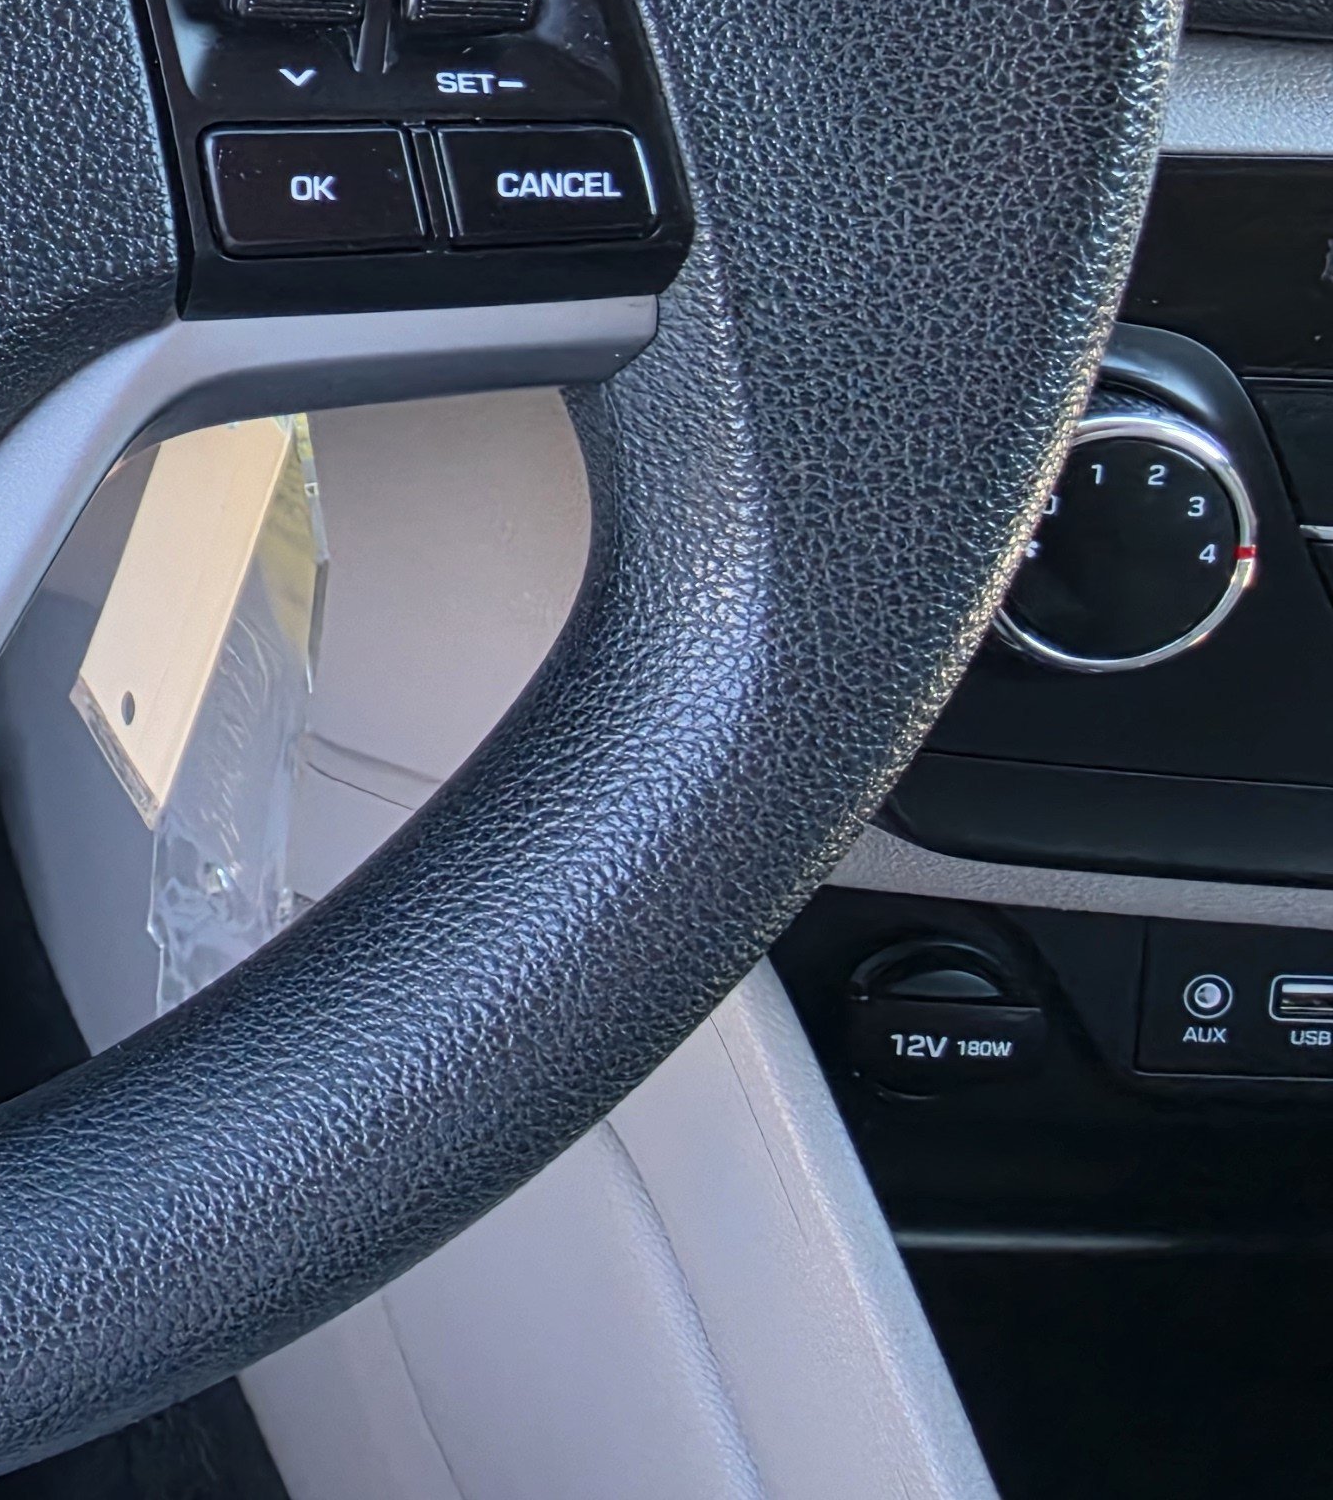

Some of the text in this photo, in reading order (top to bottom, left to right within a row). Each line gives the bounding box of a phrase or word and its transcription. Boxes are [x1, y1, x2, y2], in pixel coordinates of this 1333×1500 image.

[290, 176, 336, 200] OK
[497, 172, 621, 198] CANCEL
[1091, 464, 1166, 485] 1 2
[1188, 496, 1206, 517] 3
[1199, 544, 1216, 564] 4
[1182, 1026, 1227, 1044] AUX
[1290, 1029, 1332, 1047] USB
[890, 1034, 1012, 1058] 12V 180W
